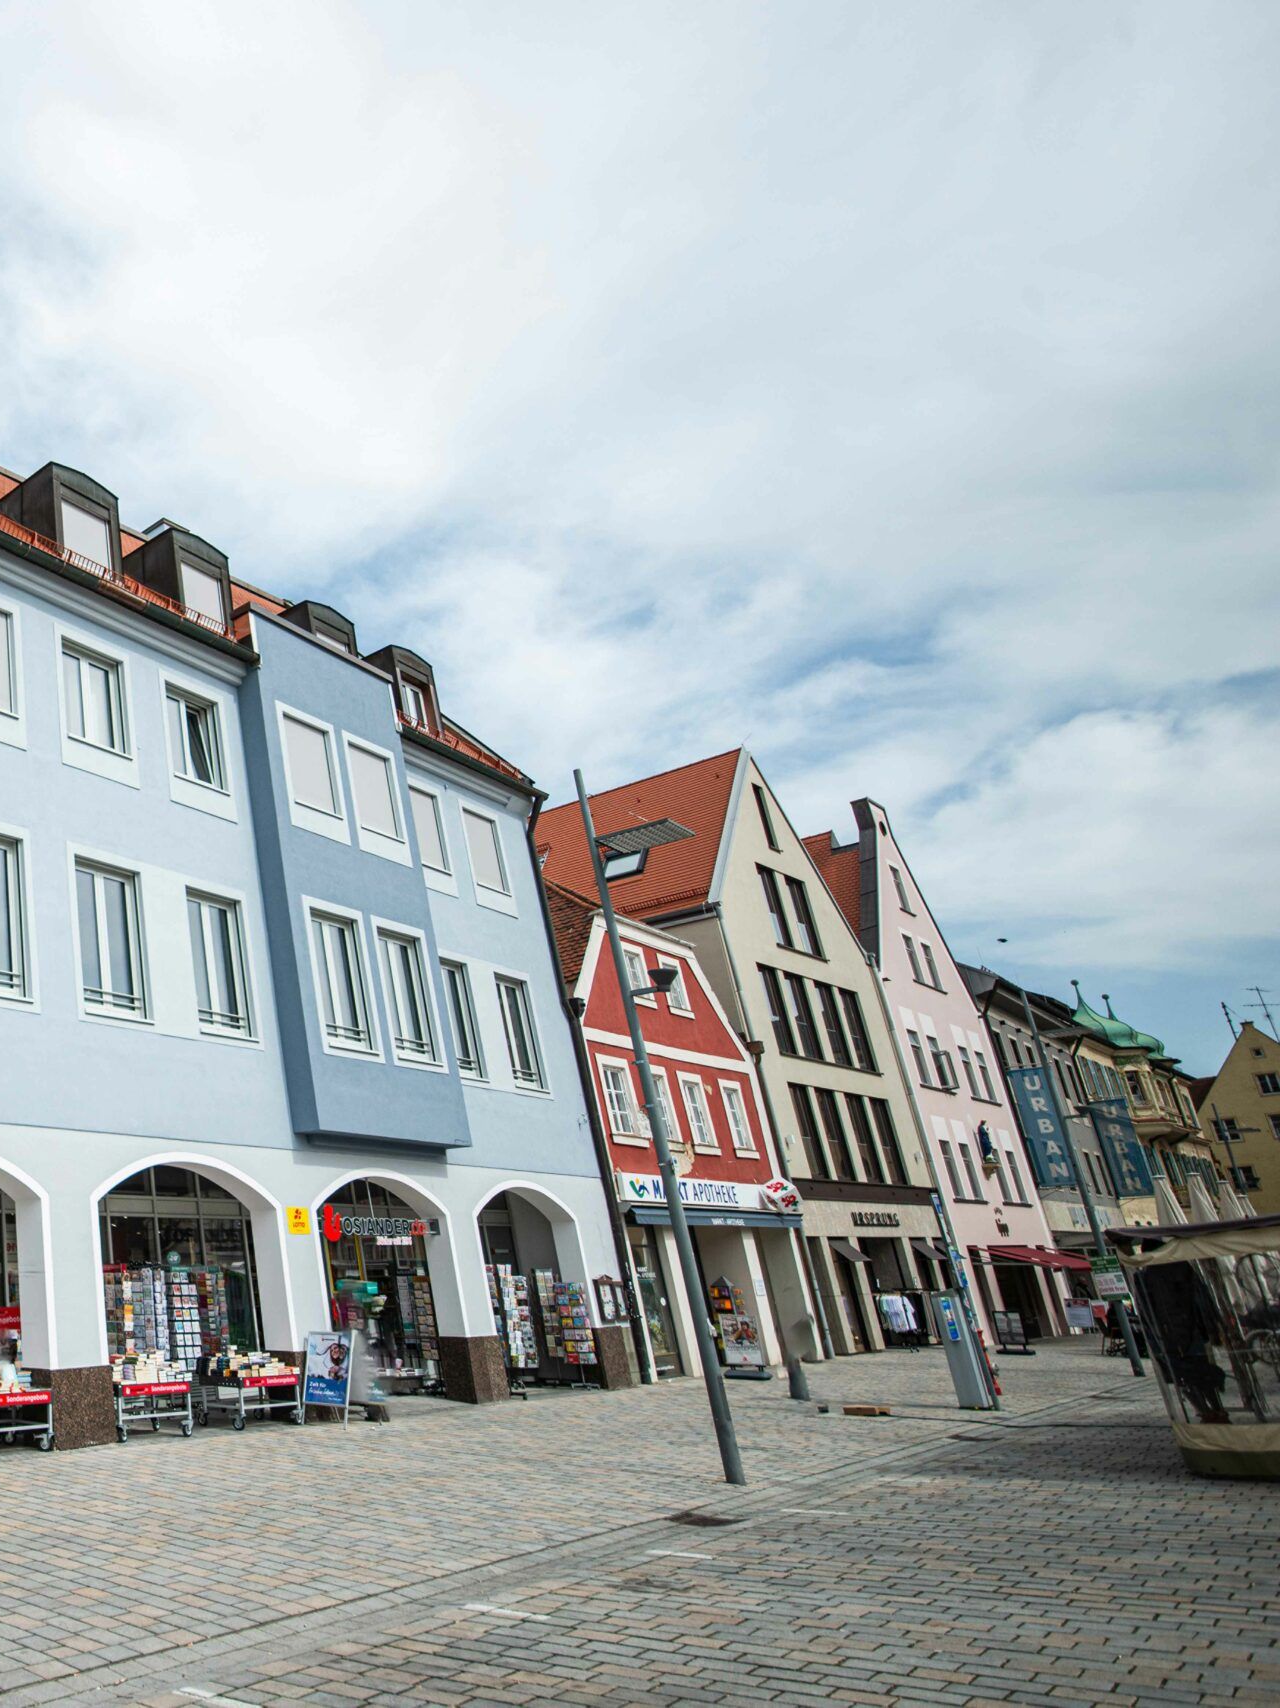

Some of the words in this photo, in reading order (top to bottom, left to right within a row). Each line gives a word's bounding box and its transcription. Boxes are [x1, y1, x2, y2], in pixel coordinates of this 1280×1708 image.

[1023, 1075, 1070, 1178] URBAN
[1101, 1105, 1142, 1190] URBAN
[652, 1179, 689, 1201] MKT
[692, 1182, 739, 1204] APOTHEKE
[850, 1211, 900, 1227] URSPRUNG
[6, 1393, 49, 1403] Sonderangebote
